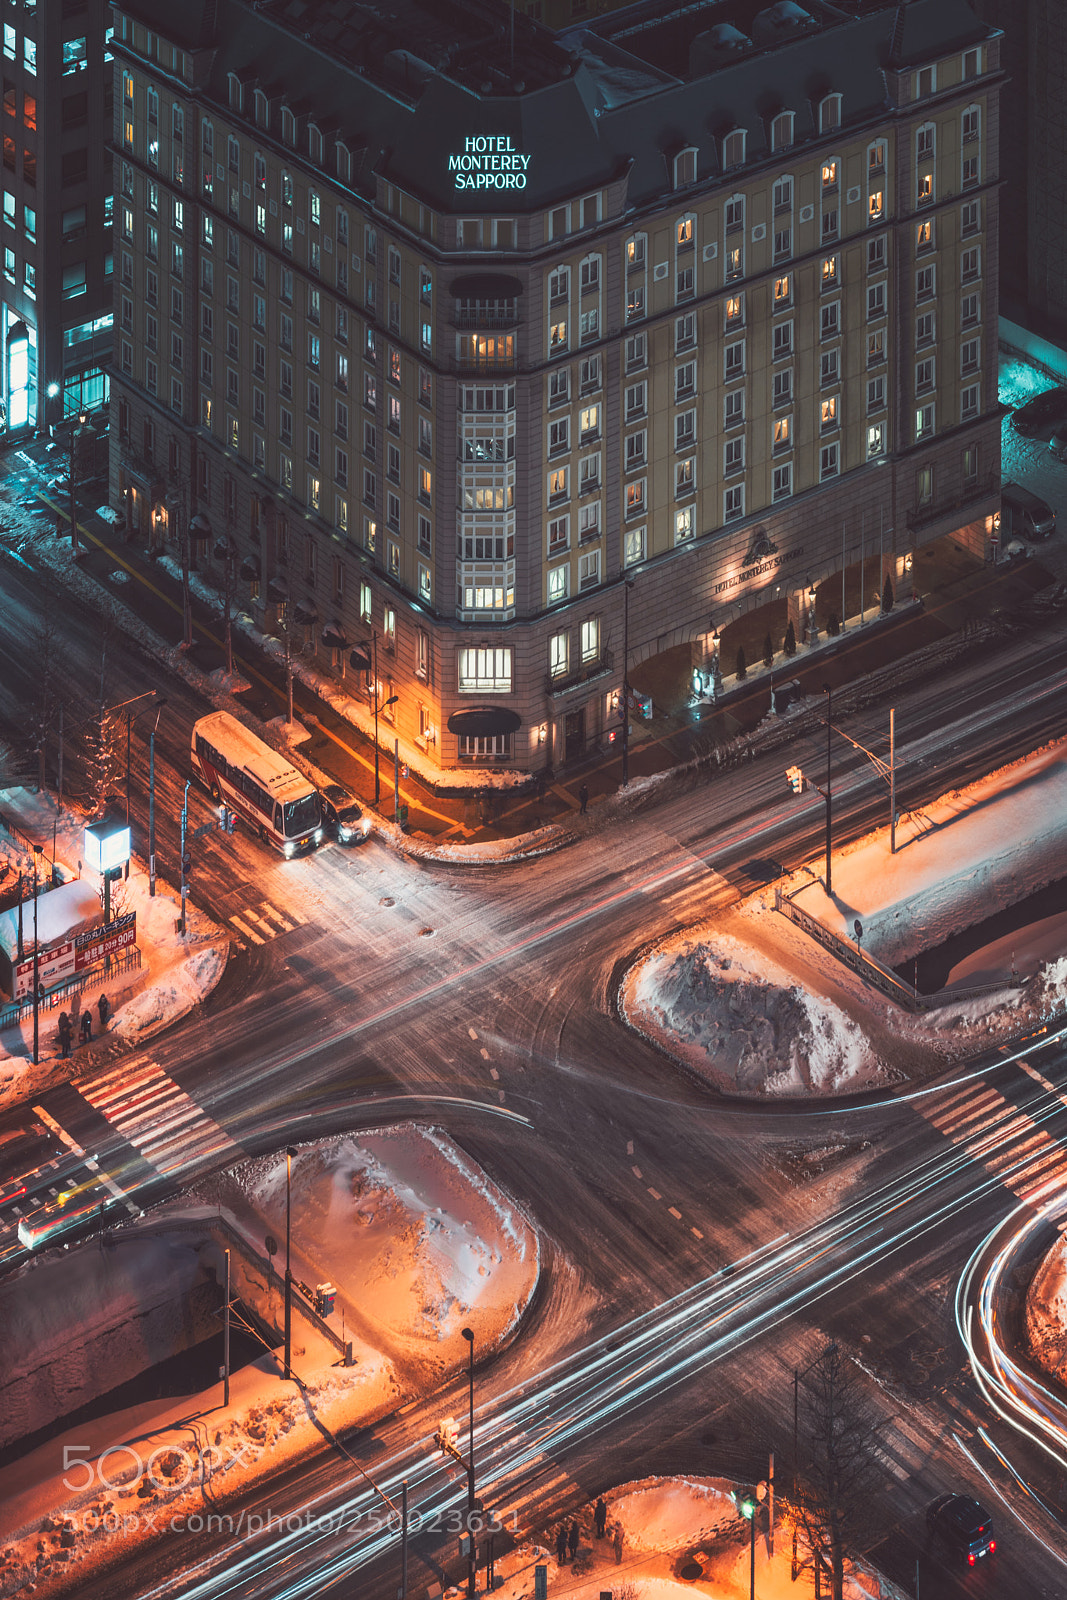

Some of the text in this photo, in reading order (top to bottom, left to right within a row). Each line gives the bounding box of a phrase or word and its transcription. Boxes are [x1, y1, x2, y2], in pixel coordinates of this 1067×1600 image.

[465, 136, 516, 152] HOTEL
[448, 155, 531, 170] MONTEREY
[455, 173, 527, 189] SAPPORO
[714, 577, 738, 594] HOTEL
[739, 560, 774, 583] MONTEREY
